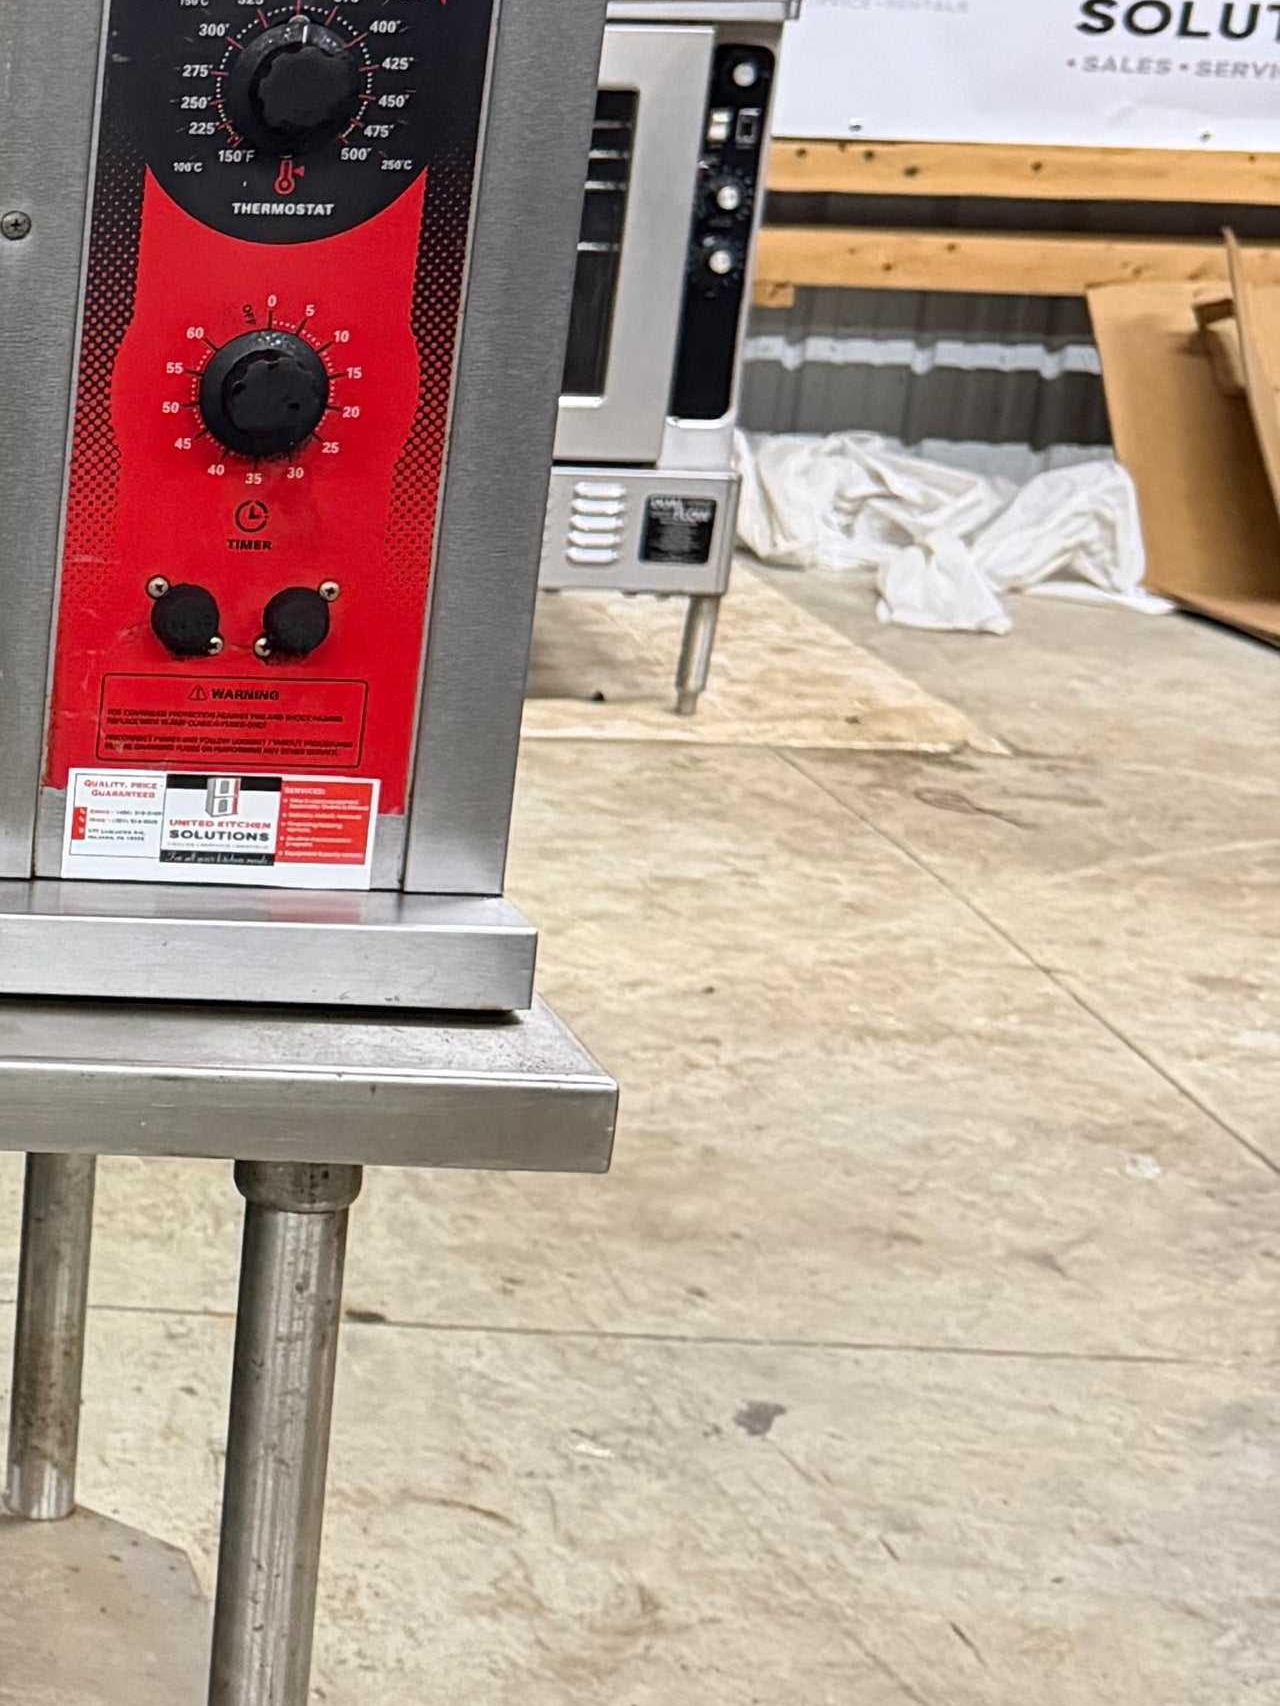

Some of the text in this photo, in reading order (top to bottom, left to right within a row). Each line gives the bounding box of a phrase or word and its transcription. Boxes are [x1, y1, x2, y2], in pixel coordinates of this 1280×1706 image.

[1082, 55, 1171, 76] SALES
[232, 202, 335, 216] THERMOSTAT
[267, 295, 277, 307] 0
[242, 304, 256, 325] OFF
[305, 304, 315, 317] 5
[186, 327, 204, 340] 60
[334, 330, 349, 343] 10
[166, 362, 183, 374] 55
[346, 367, 362, 380] 15
[162, 401, 179, 414] 50
[342, 406, 360, 418] 20
[174, 437, 191, 450] 45
[322, 442, 339, 454] 25
[207, 464, 225, 476] 40
[287, 467, 304, 479] 30
[245, 473, 262, 485] 35
[227, 539, 272, 550] TIMER
[211, 688, 279, 701] WARNING
[169, 819, 271, 829] UNITED KITCHEN
[169, 830, 269, 841] SOLUTIONS
